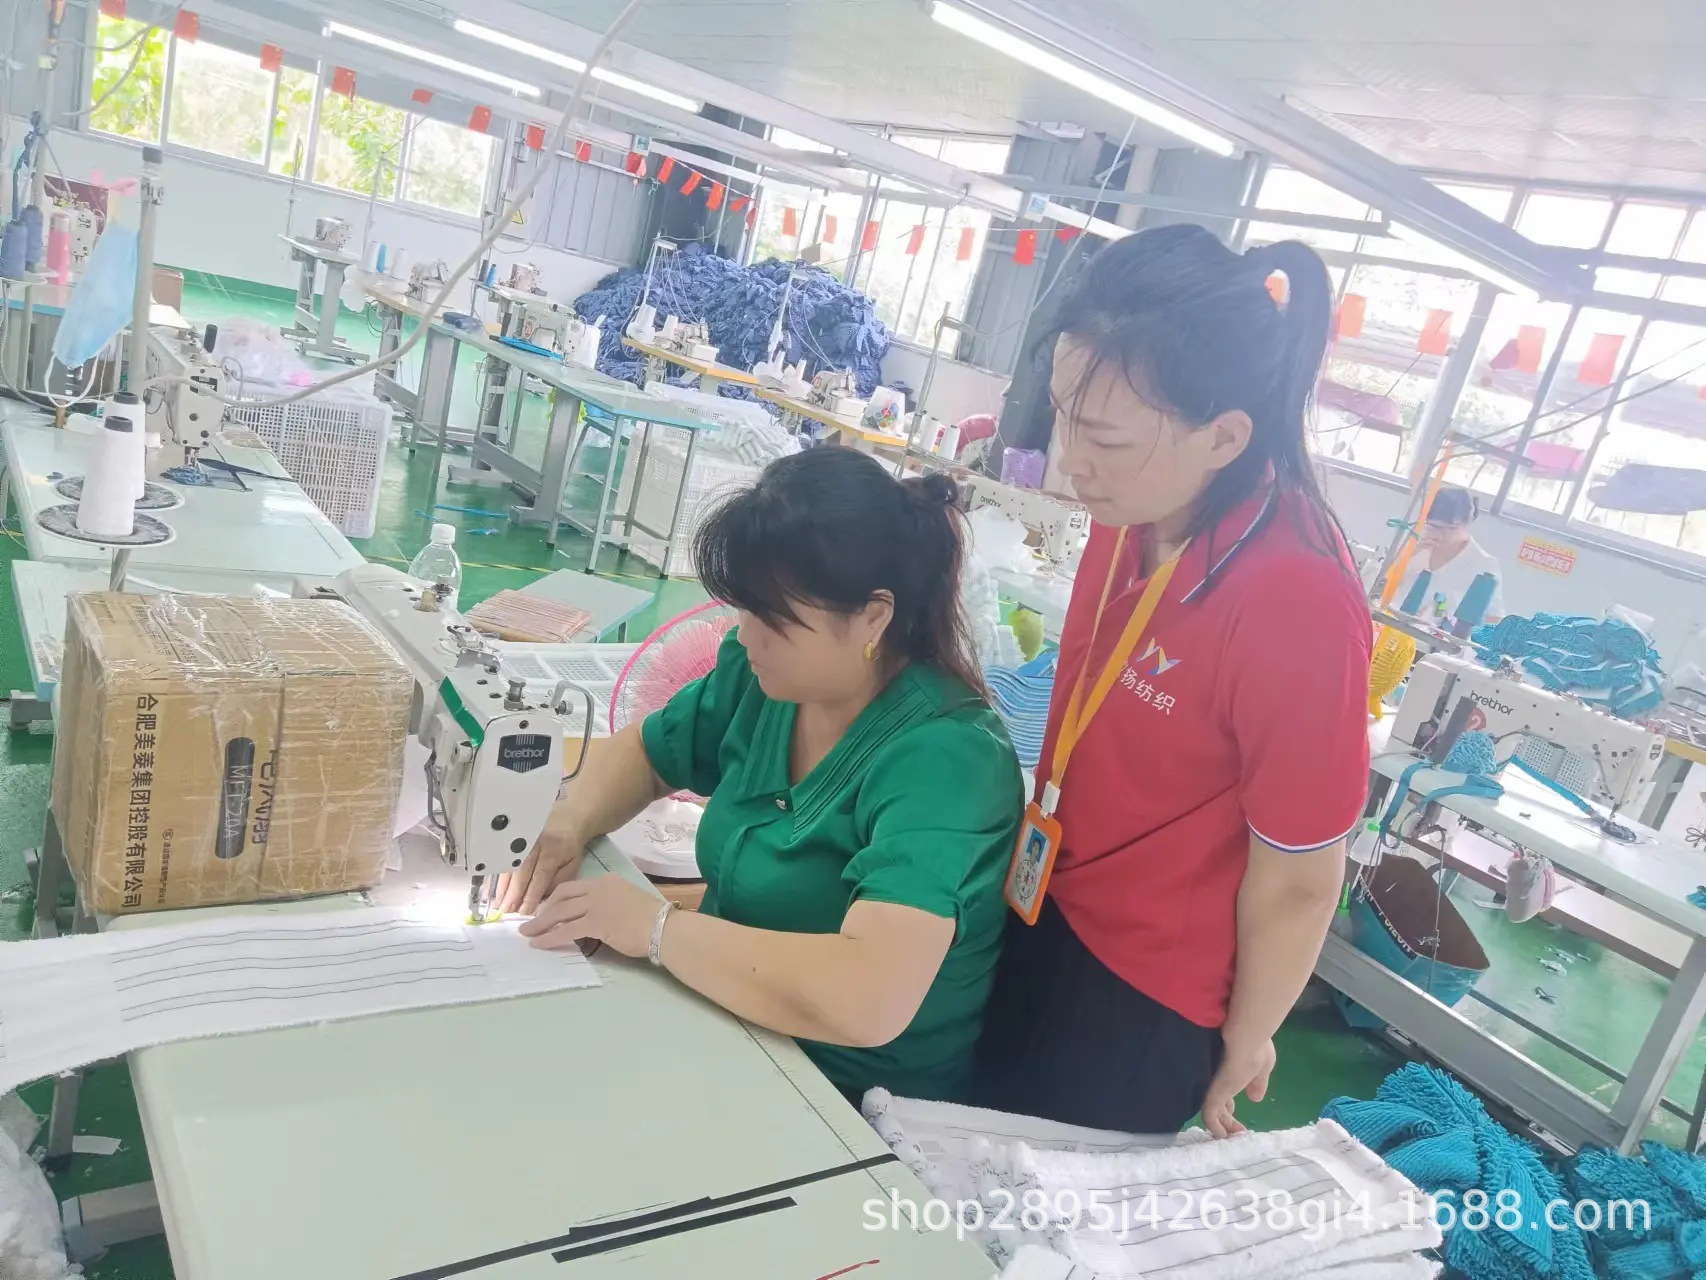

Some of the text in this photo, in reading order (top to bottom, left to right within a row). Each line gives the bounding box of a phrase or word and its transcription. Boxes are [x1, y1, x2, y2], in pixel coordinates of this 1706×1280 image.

[1120, 660, 1176, 715] 扬纺织
[122, 693, 159, 908] 合肥美菱集团控股有限公司
